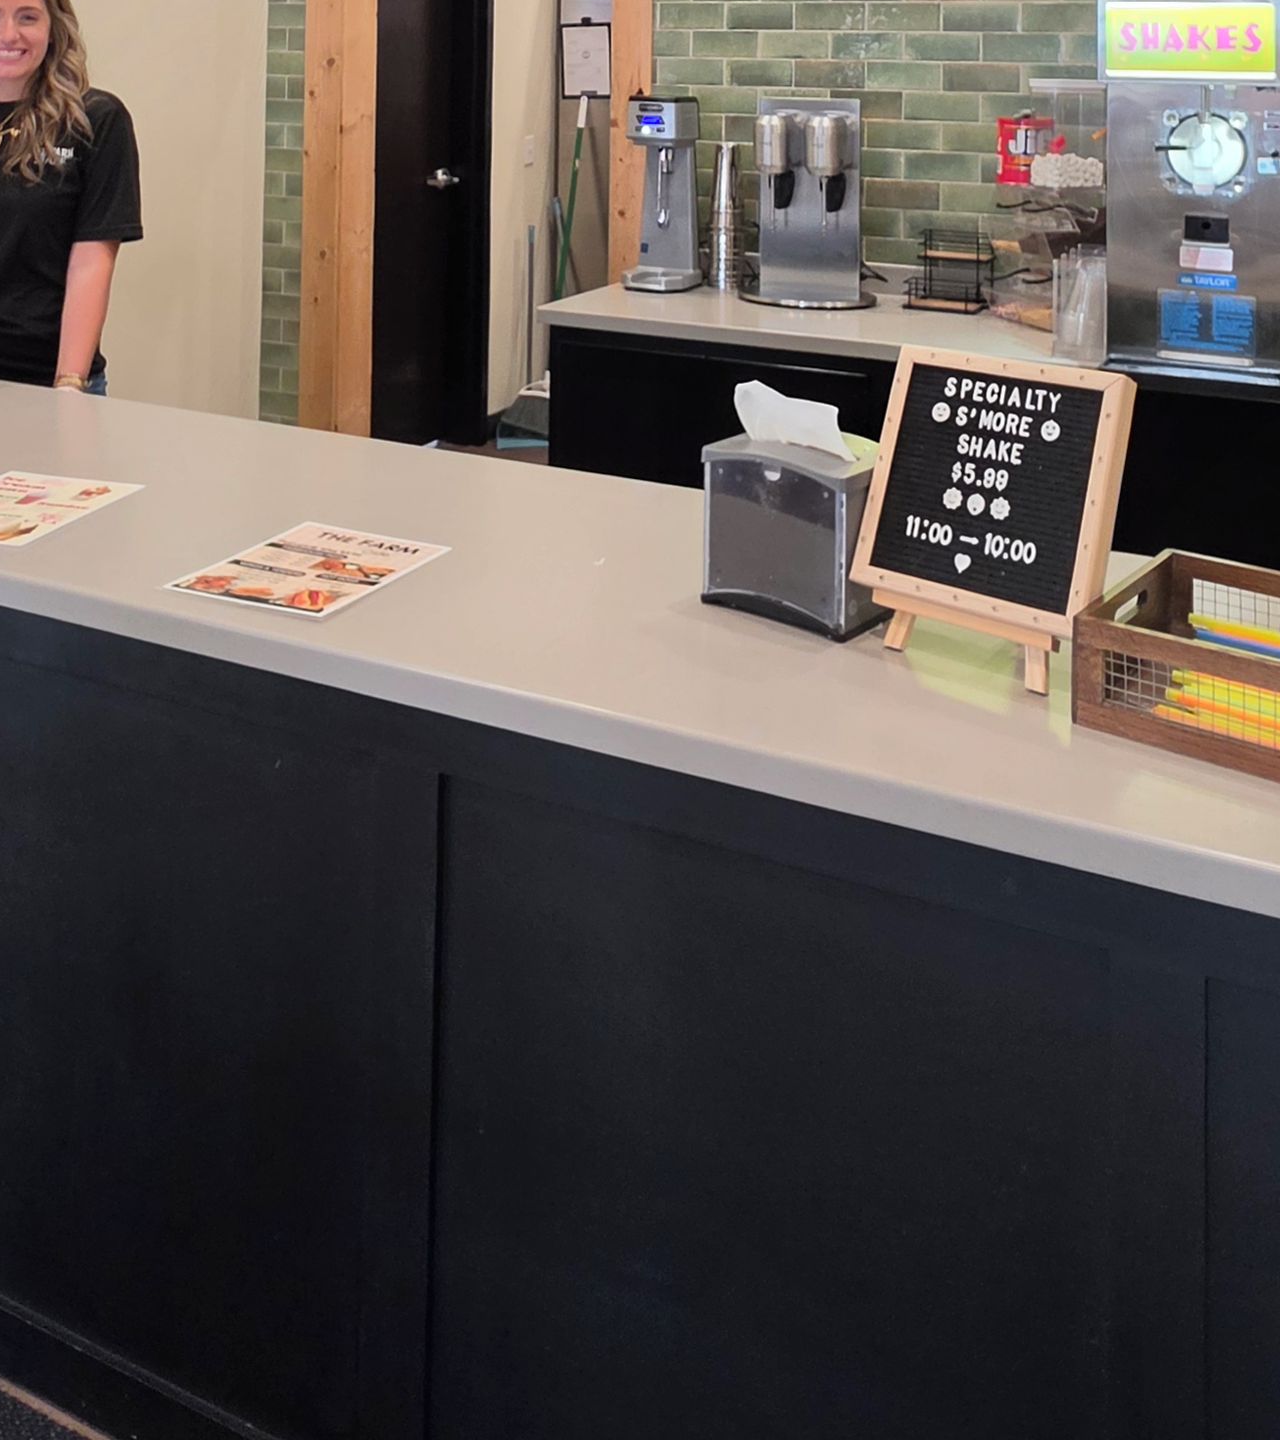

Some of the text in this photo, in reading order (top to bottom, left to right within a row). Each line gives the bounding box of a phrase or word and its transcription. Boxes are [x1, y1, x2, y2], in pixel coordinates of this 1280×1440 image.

[1119, 23, 1262, 53] SHAKES
[943, 377, 1062, 414] SPECIALTY
[955, 405, 1034, 438] S'MORE
[956, 433, 1025, 466] SHAKE
[951, 461, 1009, 492] $5.99
[319, 531, 352, 544] THE
[358, 536, 420, 556] FARM
[905, 515, 954, 546] 11:00
[983, 532, 1037, 564] 10:00
